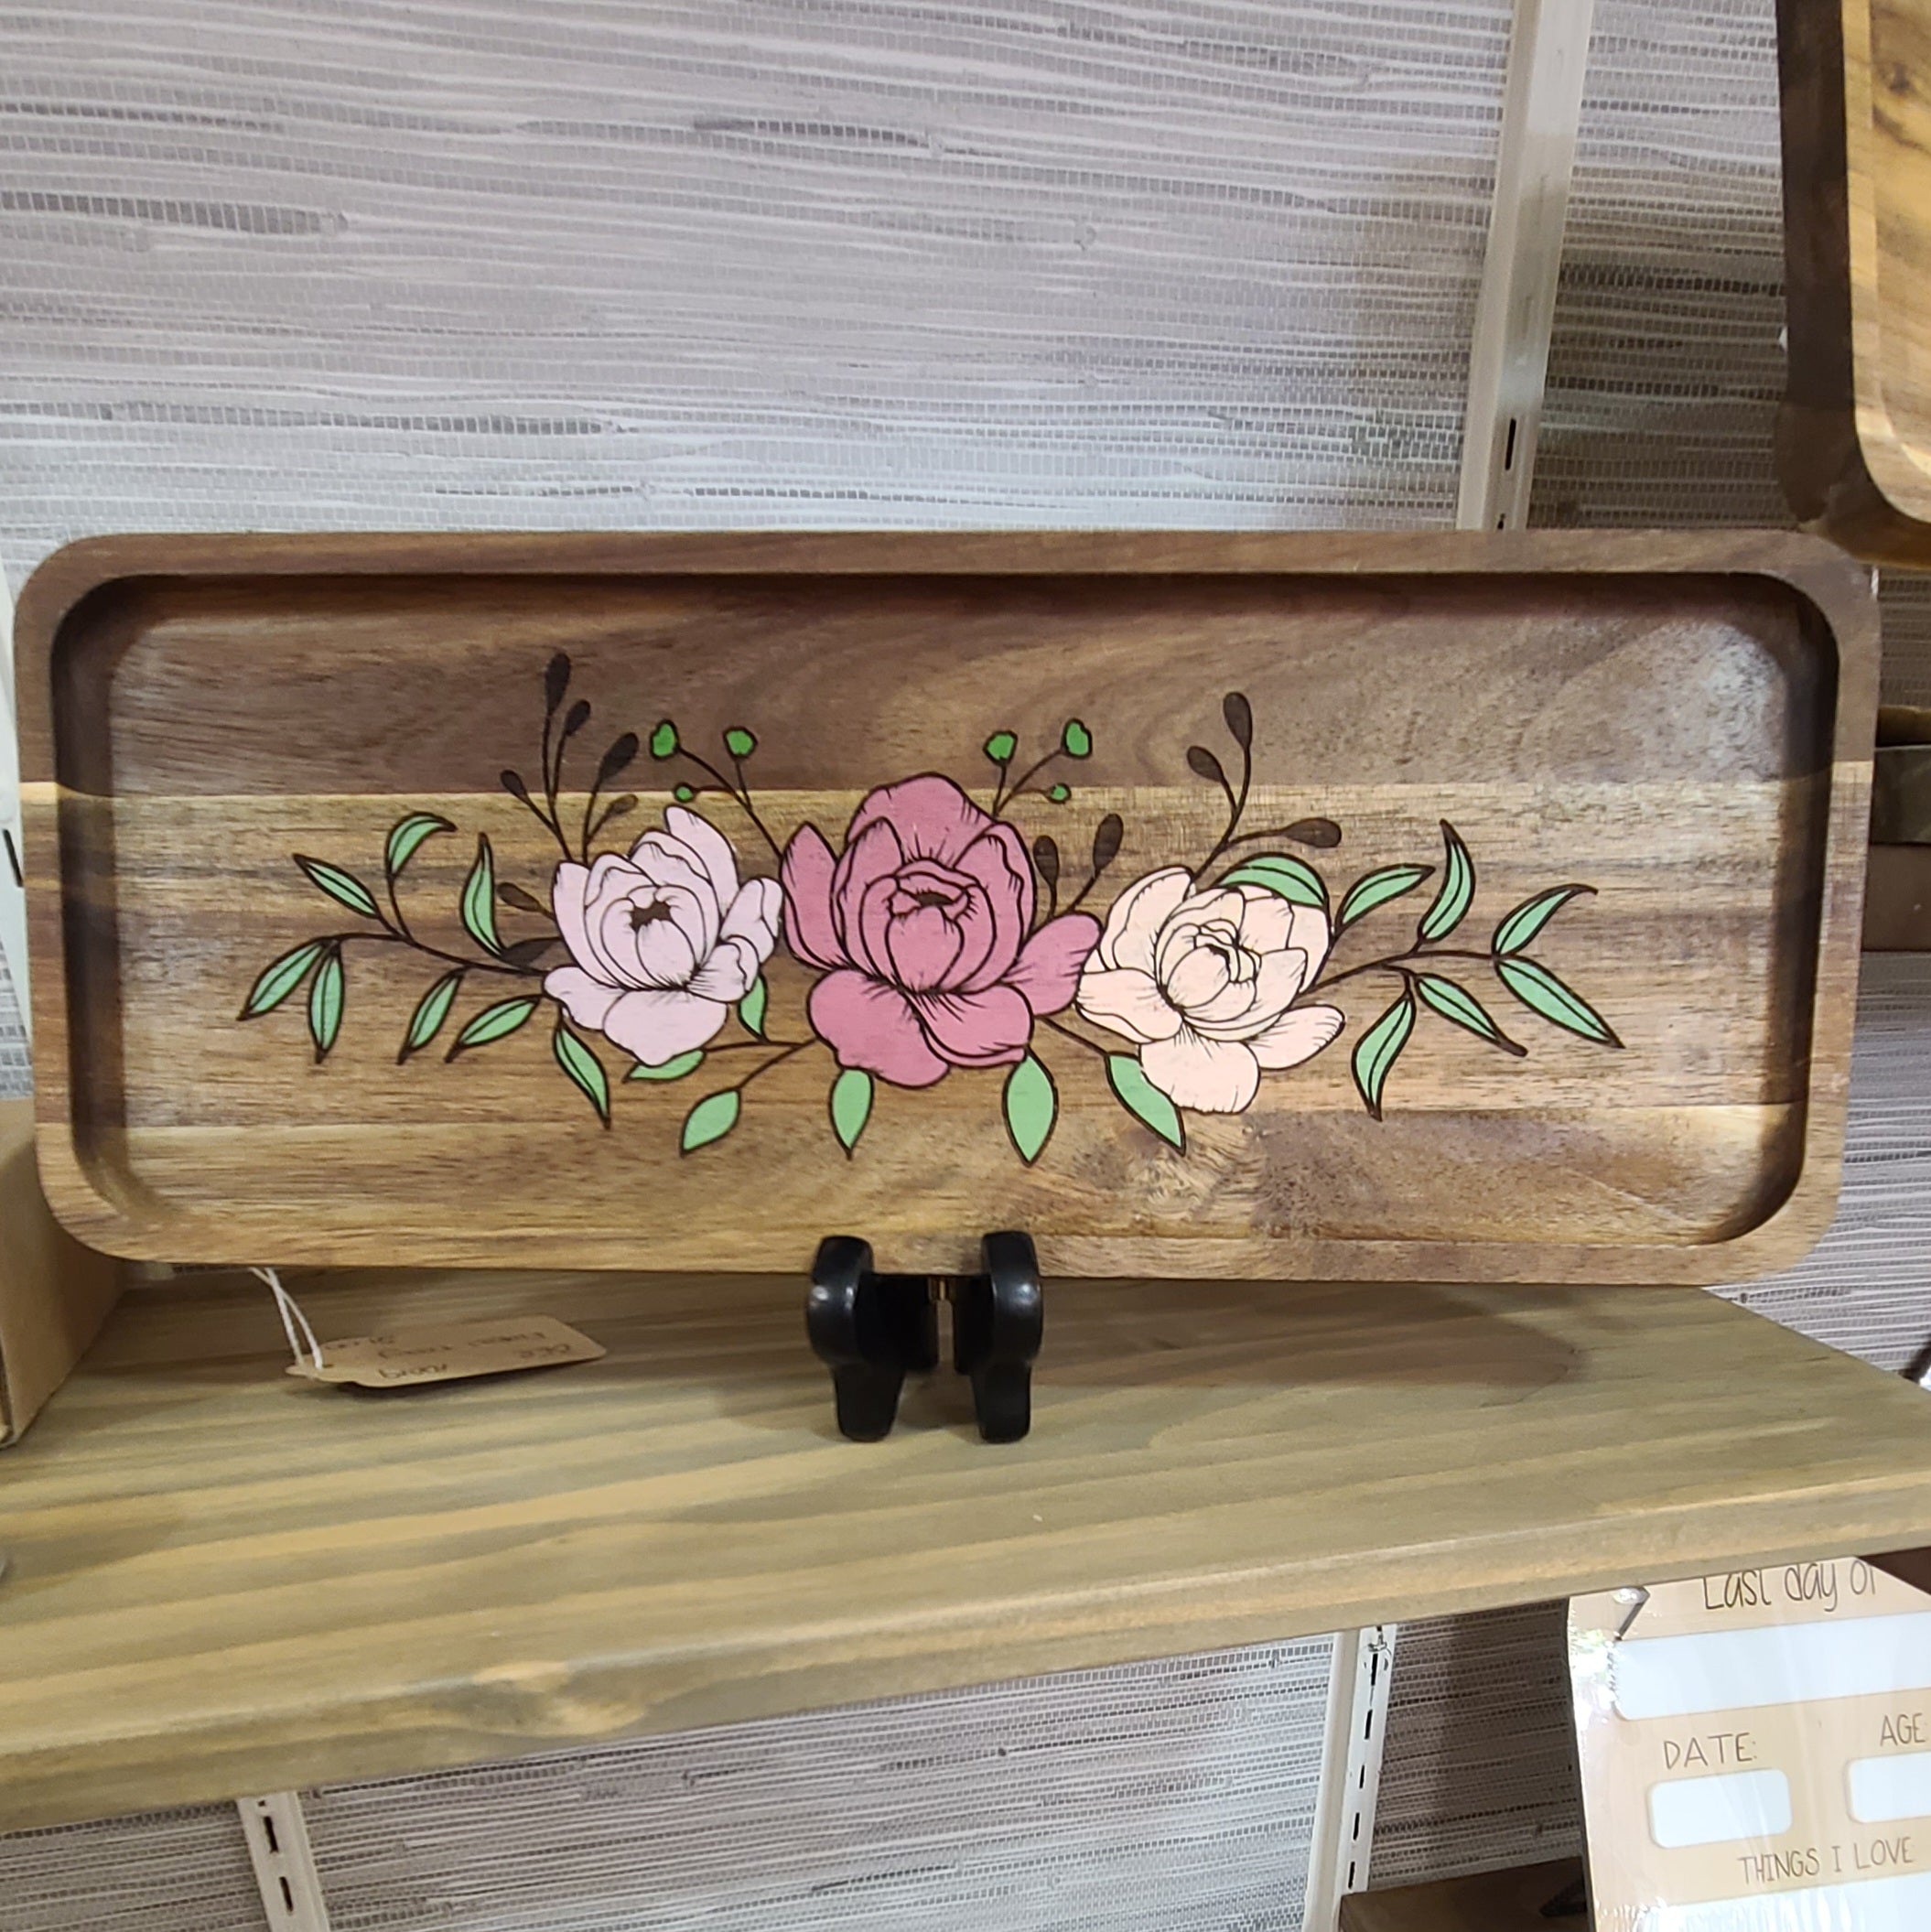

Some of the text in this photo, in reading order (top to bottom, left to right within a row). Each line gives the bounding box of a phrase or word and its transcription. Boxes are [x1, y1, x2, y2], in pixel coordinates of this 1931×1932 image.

[1784, 1560, 1839, 1613] day
[1662, 1732, 1758, 1770] DATE:
[1737, 1847, 1821, 1884] THINGS
[1831, 1845, 1842, 1873] I
